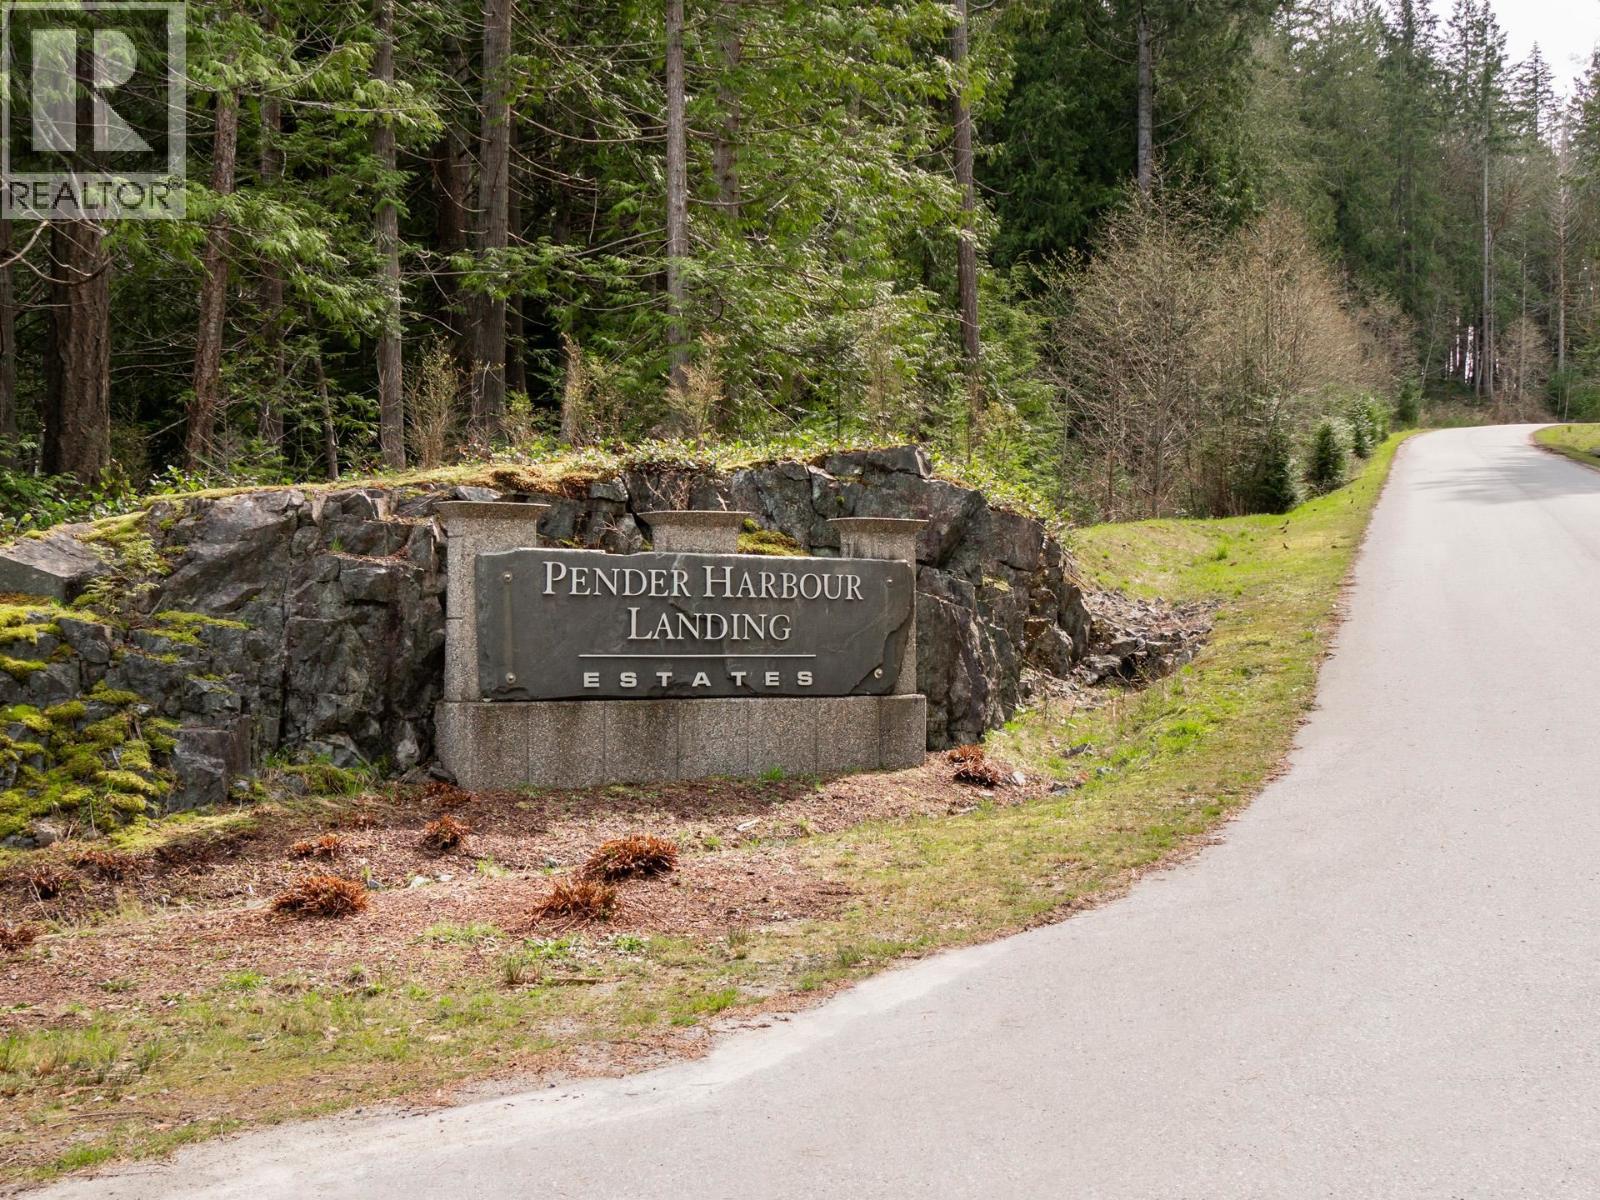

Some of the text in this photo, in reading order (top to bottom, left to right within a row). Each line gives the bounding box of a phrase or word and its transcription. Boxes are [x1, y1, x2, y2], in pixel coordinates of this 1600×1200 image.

[542, 561, 864, 600] PENDER HARBOUR
[627, 607, 793, 641] LANDING
[583, 670, 814, 688] ESTATES
